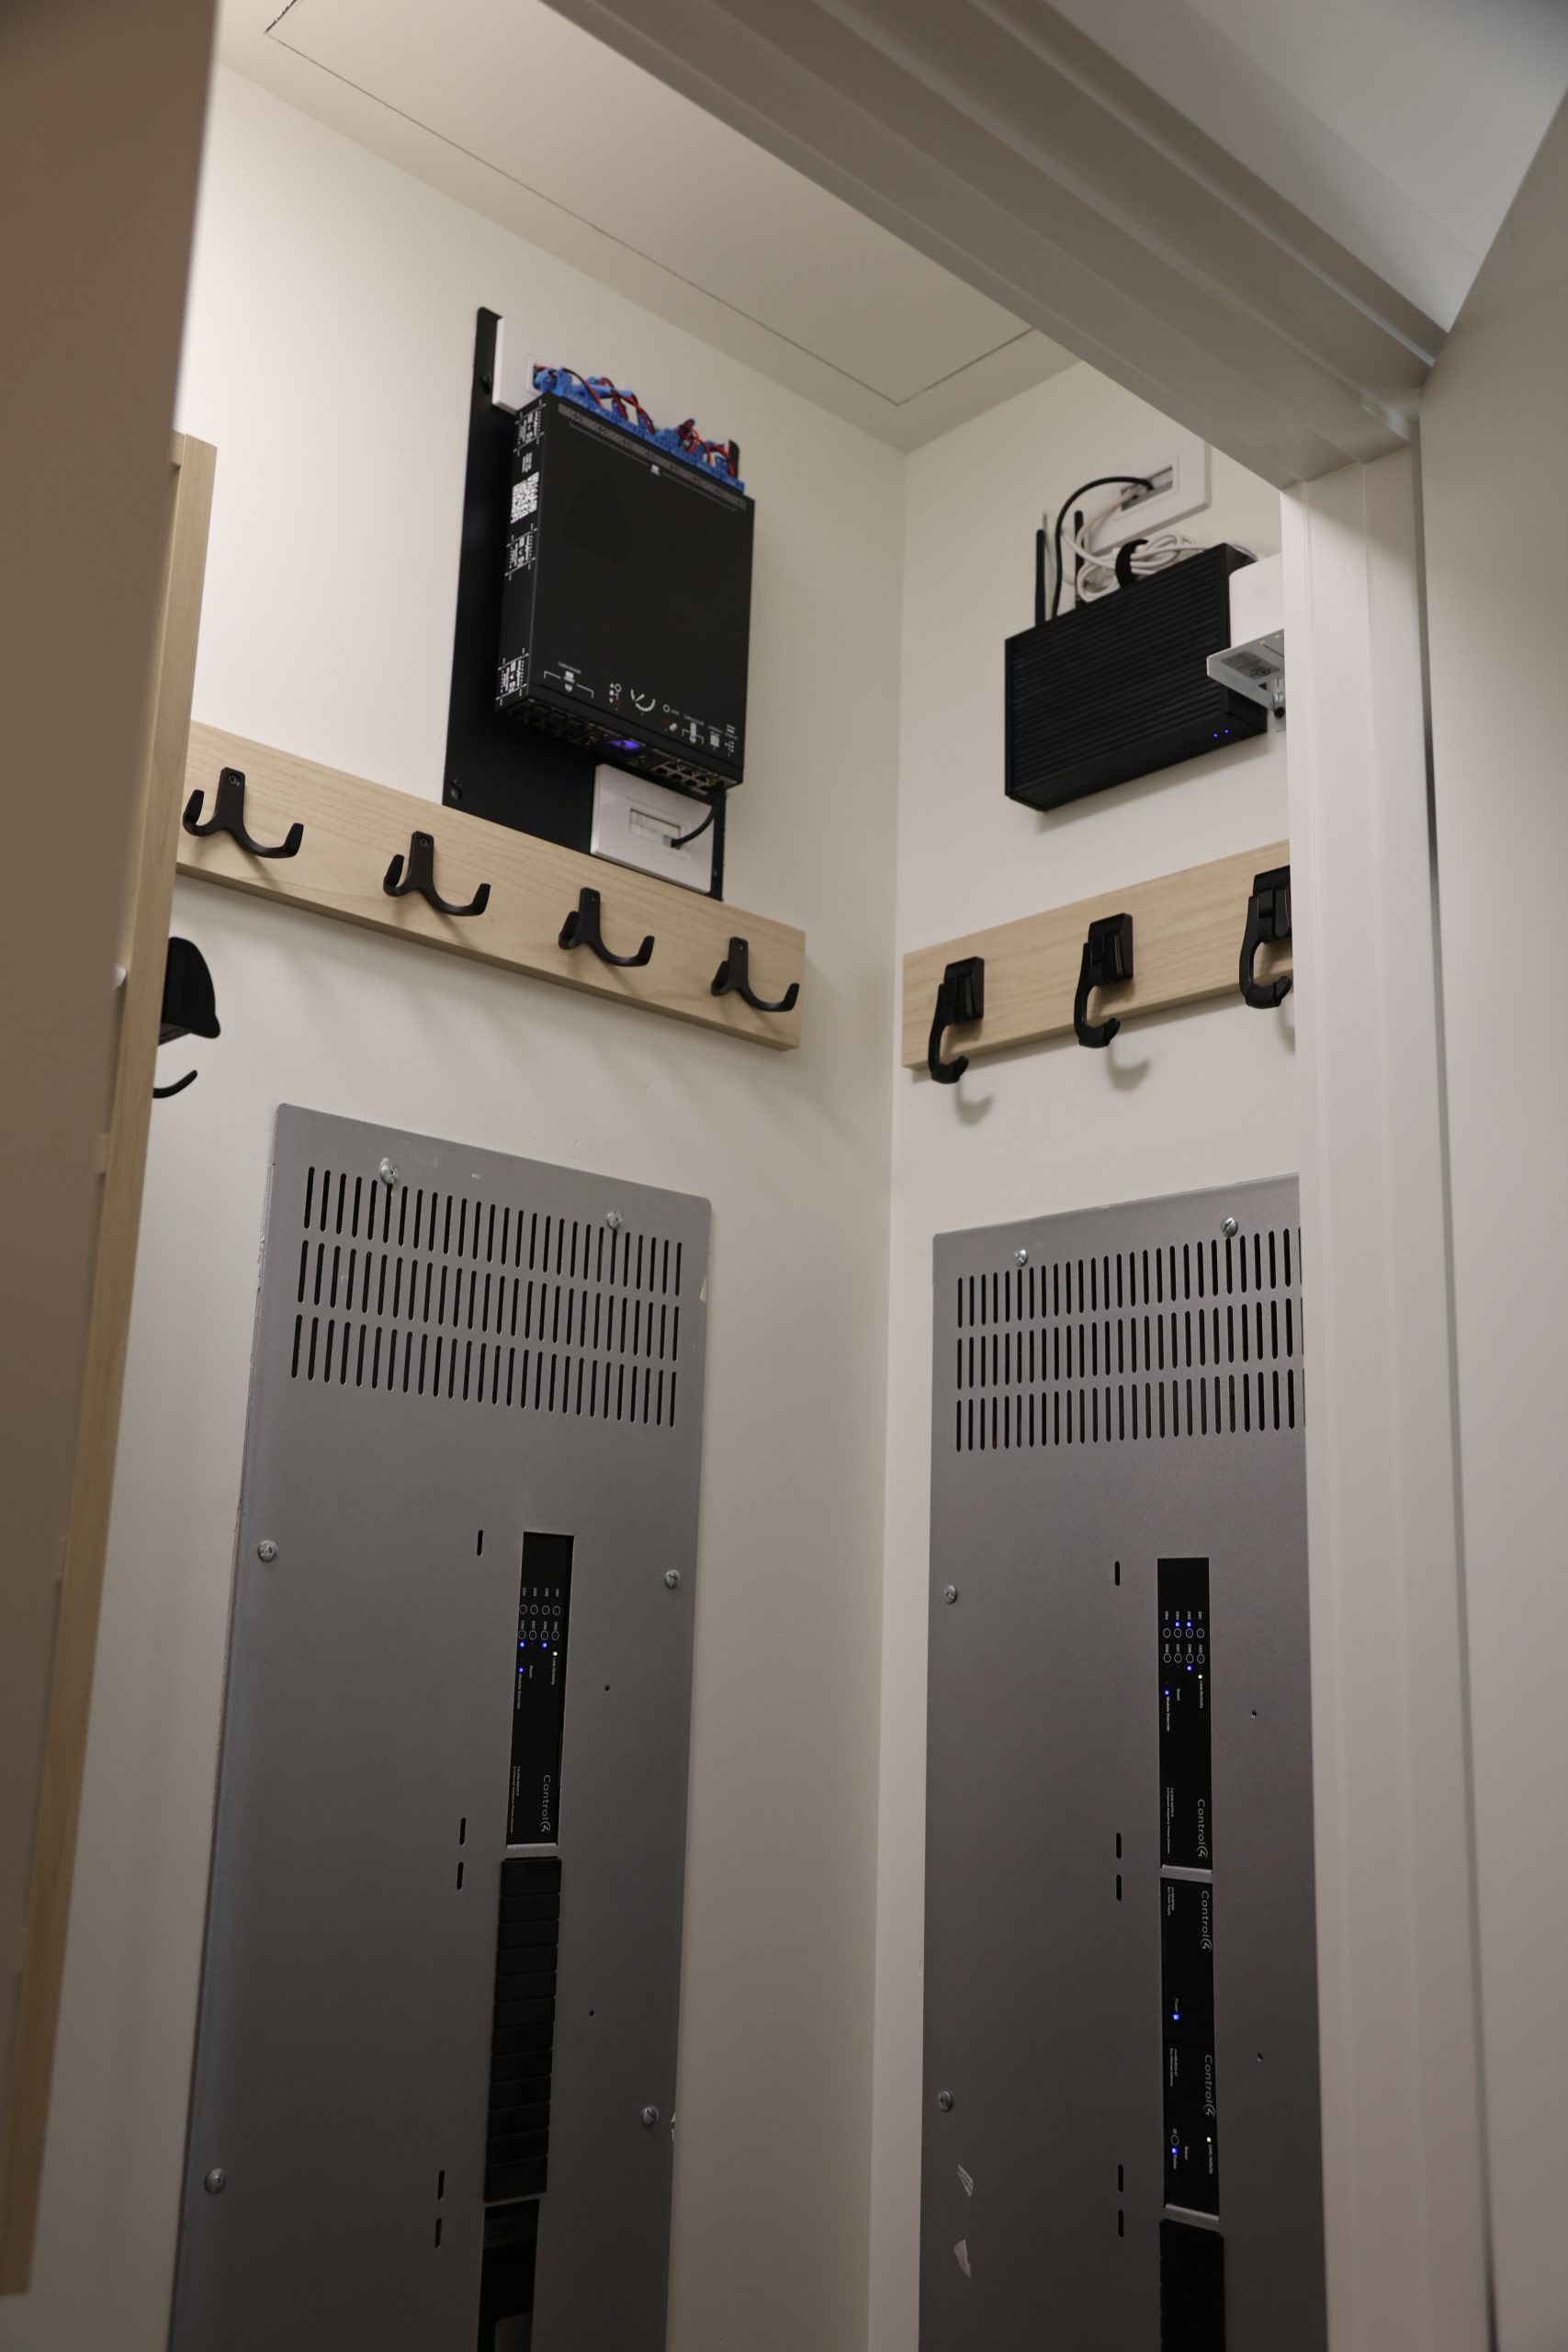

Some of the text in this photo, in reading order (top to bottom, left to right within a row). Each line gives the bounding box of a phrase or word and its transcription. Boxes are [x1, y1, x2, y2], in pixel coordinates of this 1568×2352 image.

[539, 1775, 551, 1834] Control4
[1197, 1799, 1208, 1860] Control4
[1201, 1891, 1212, 1953] Control4
[1203, 2054, 1215, 2119] Control4
